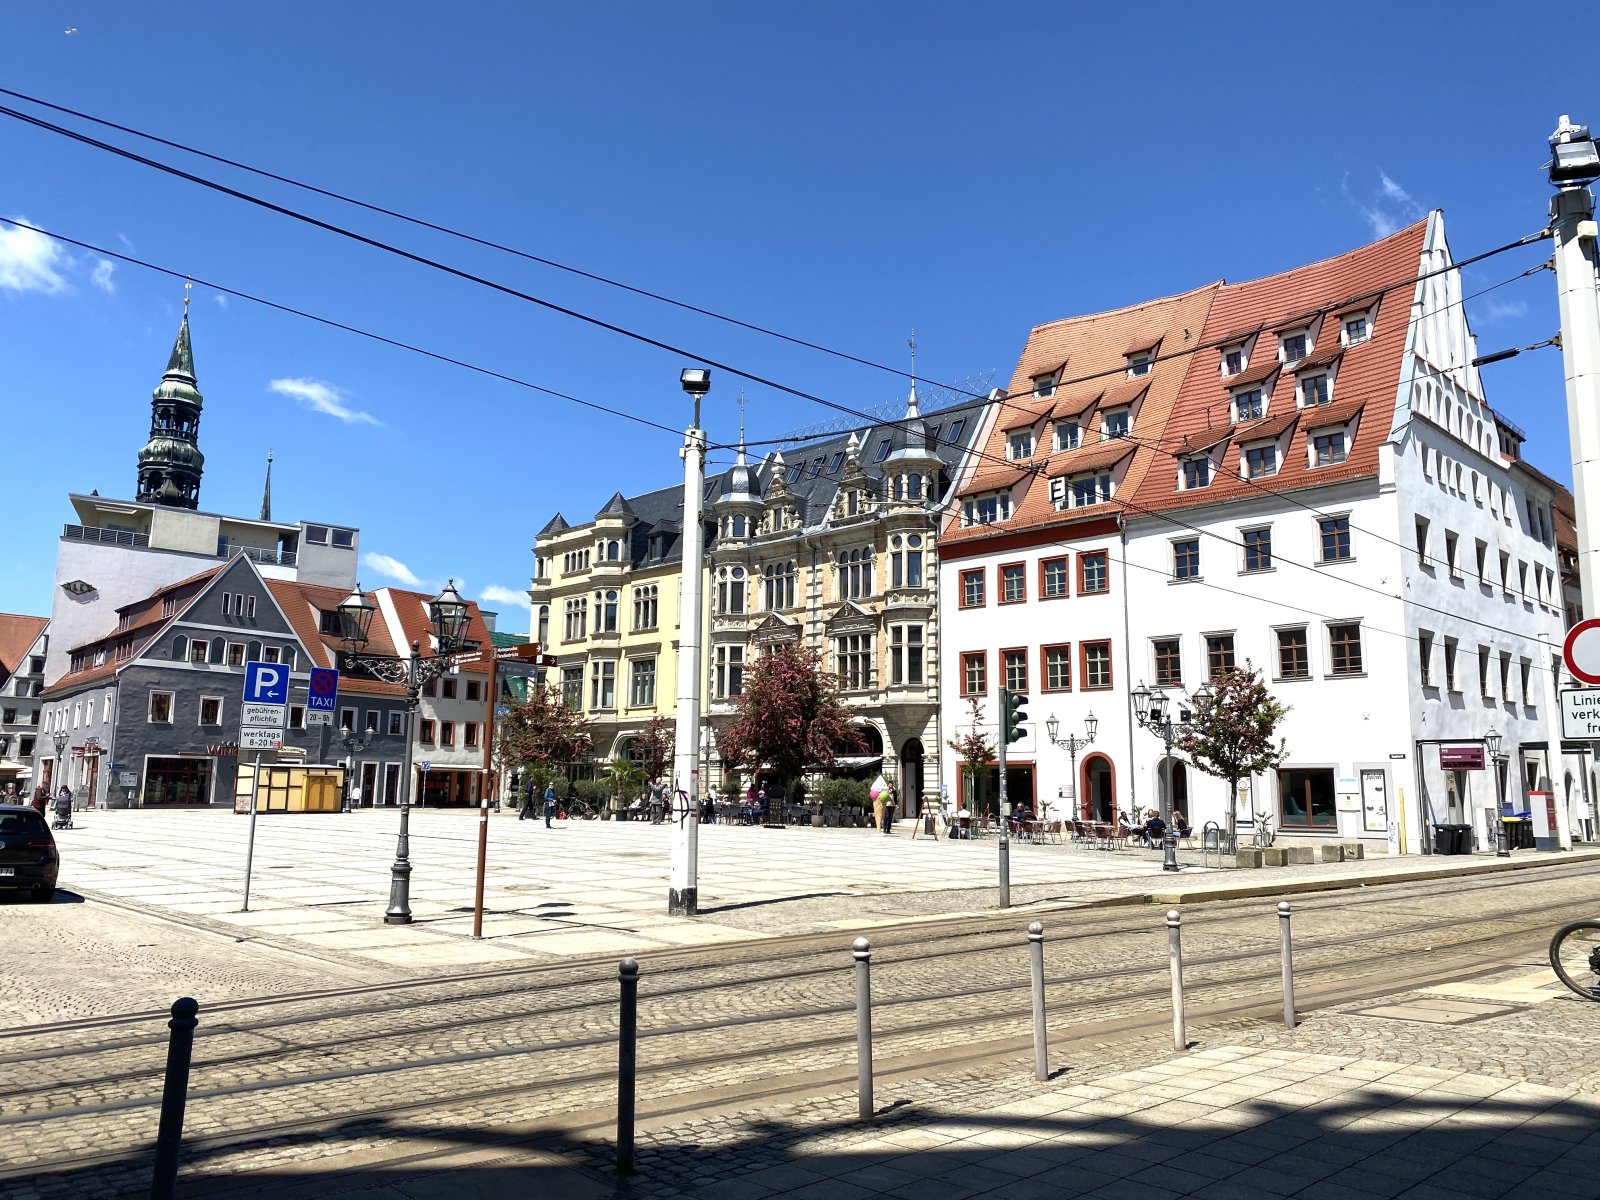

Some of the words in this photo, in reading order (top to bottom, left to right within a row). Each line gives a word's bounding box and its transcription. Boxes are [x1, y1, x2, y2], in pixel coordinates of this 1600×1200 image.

[254, 667, 279, 698] P
[310, 696, 333, 708] TAXI
[246, 707, 282, 715] gebühren-
[249, 714, 277, 723] pflichtig
[1587, 722, 1600, 733] fr
[243, 728, 281, 739] werktags
[249, 739, 268, 747] 8-20
[206, 744, 240, 757] WINK
